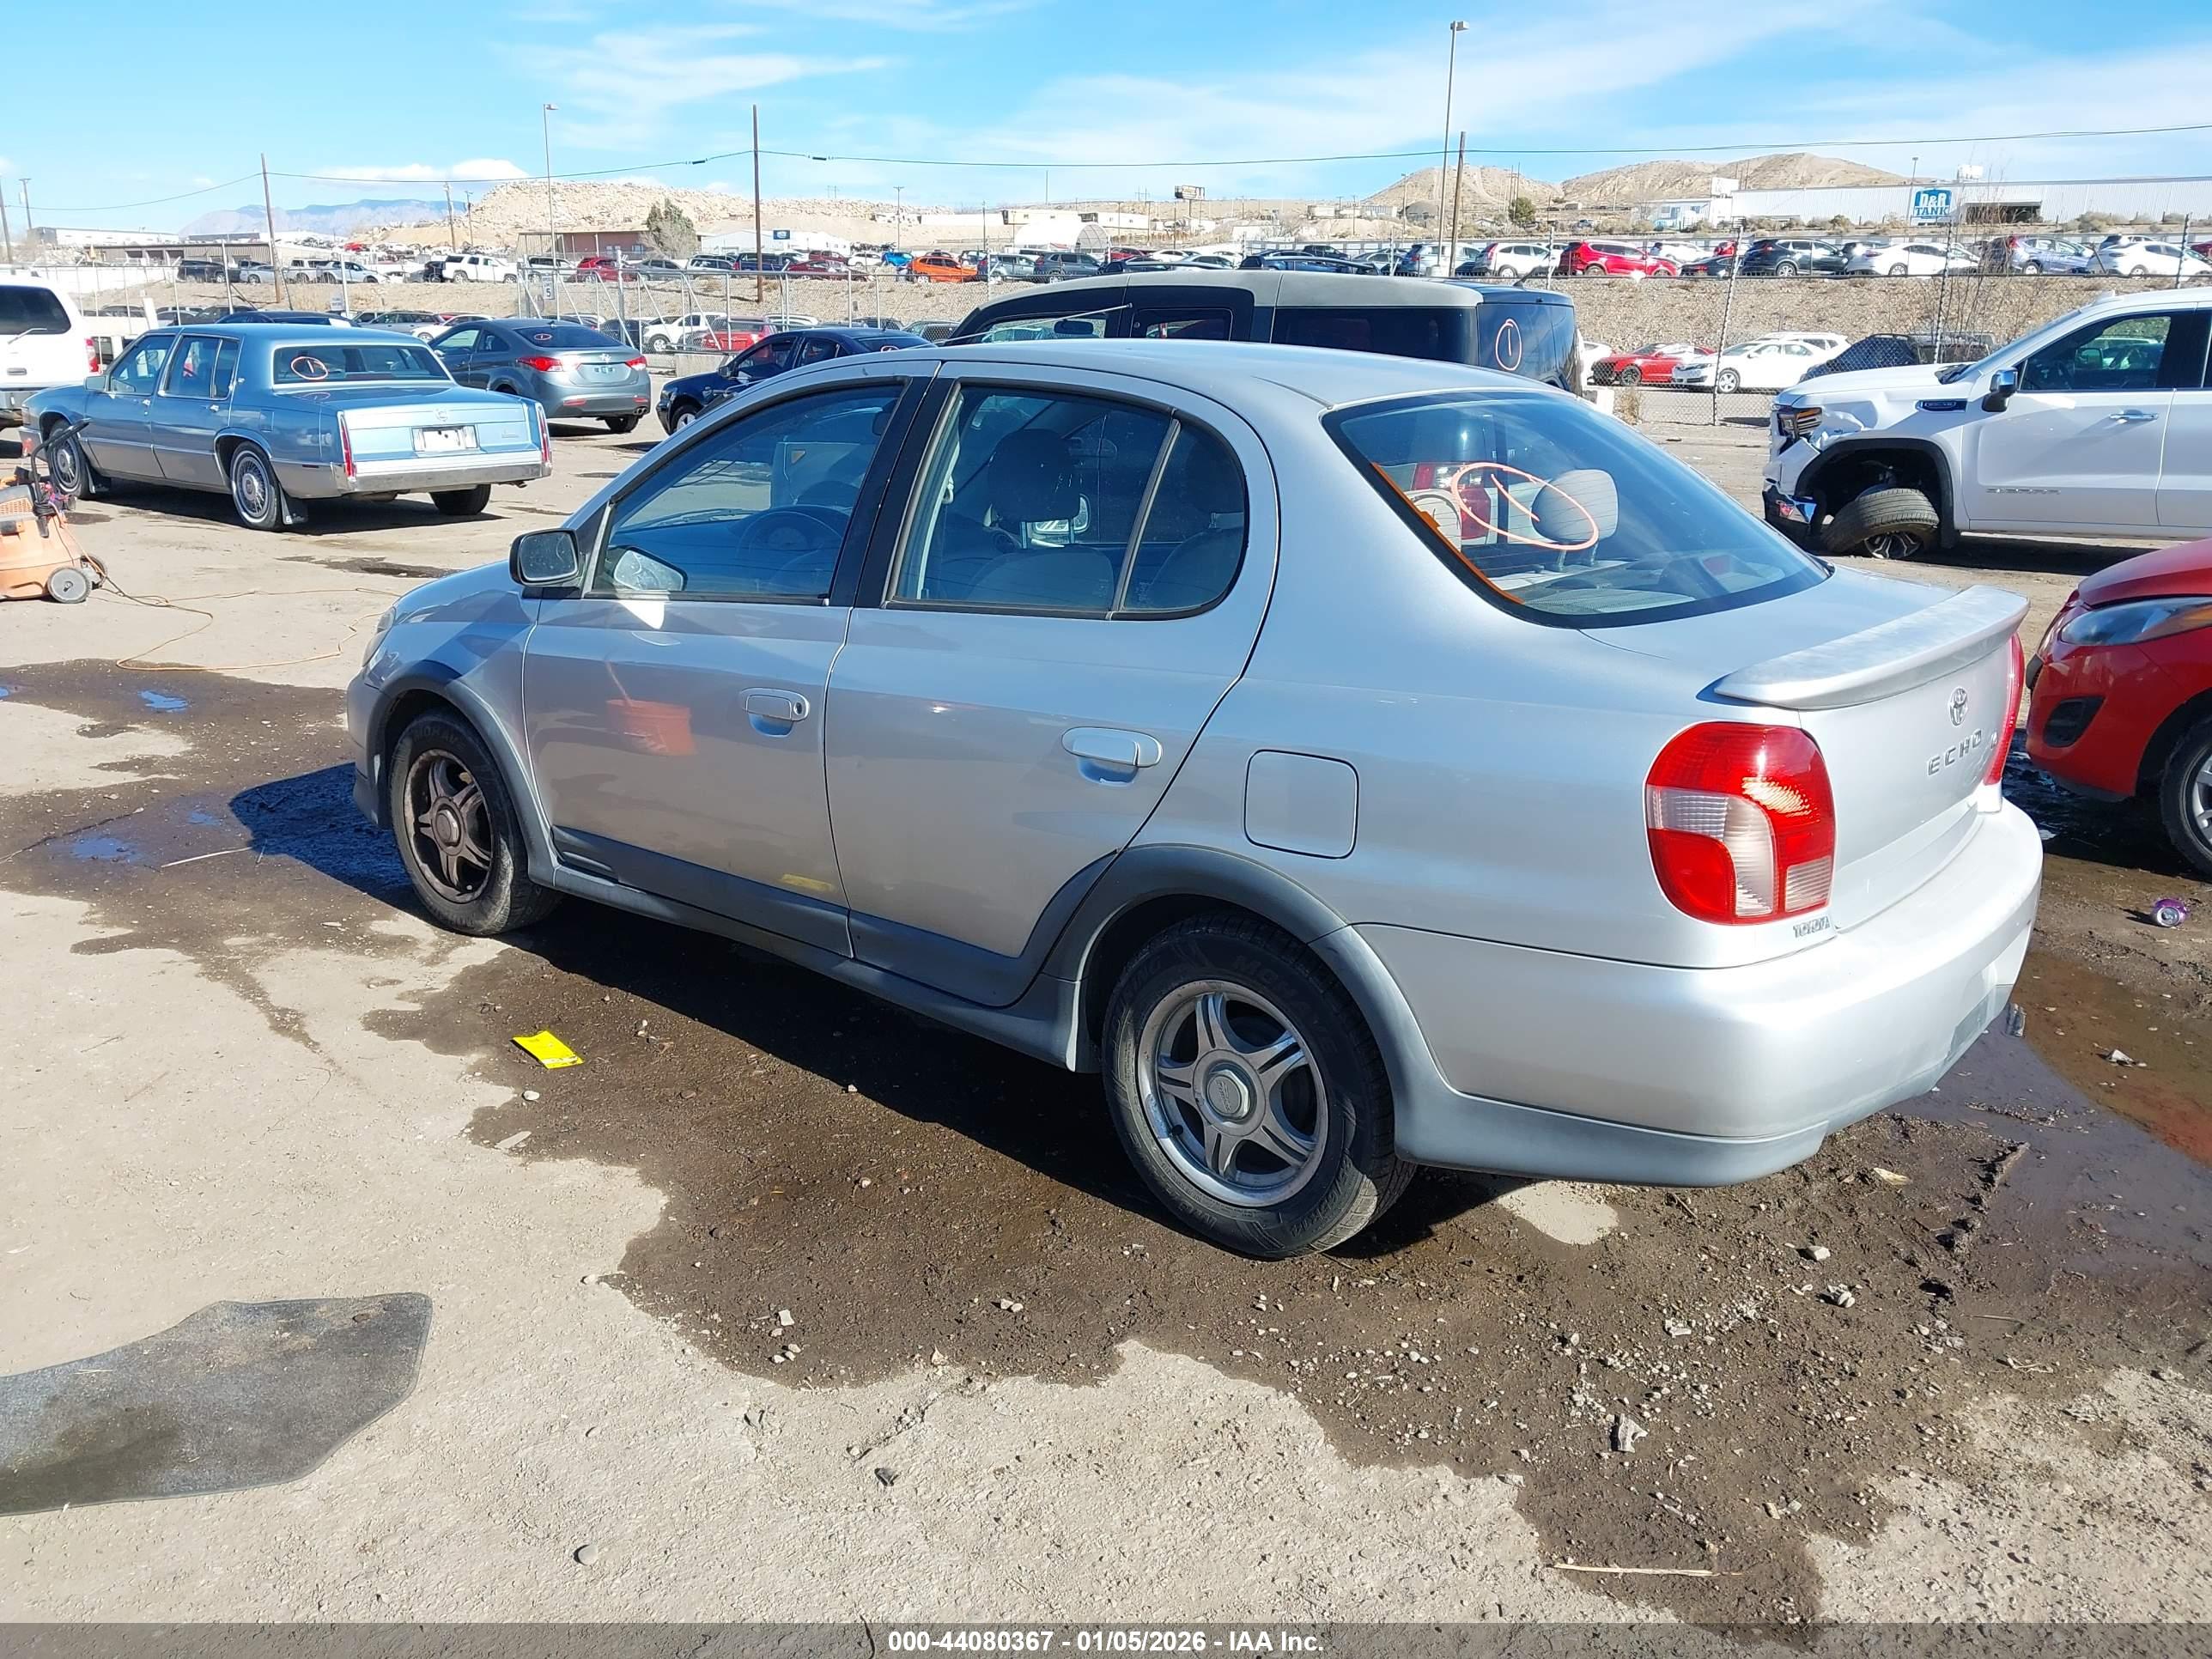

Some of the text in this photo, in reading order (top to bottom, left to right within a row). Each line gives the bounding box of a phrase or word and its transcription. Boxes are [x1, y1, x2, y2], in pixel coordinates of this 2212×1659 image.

[1919, 192, 1948, 207] D&R
[1915, 207, 1948, 216] TANK
[1927, 728, 1983, 776] ECHO
[1792, 915, 1831, 939] TOYOTA
